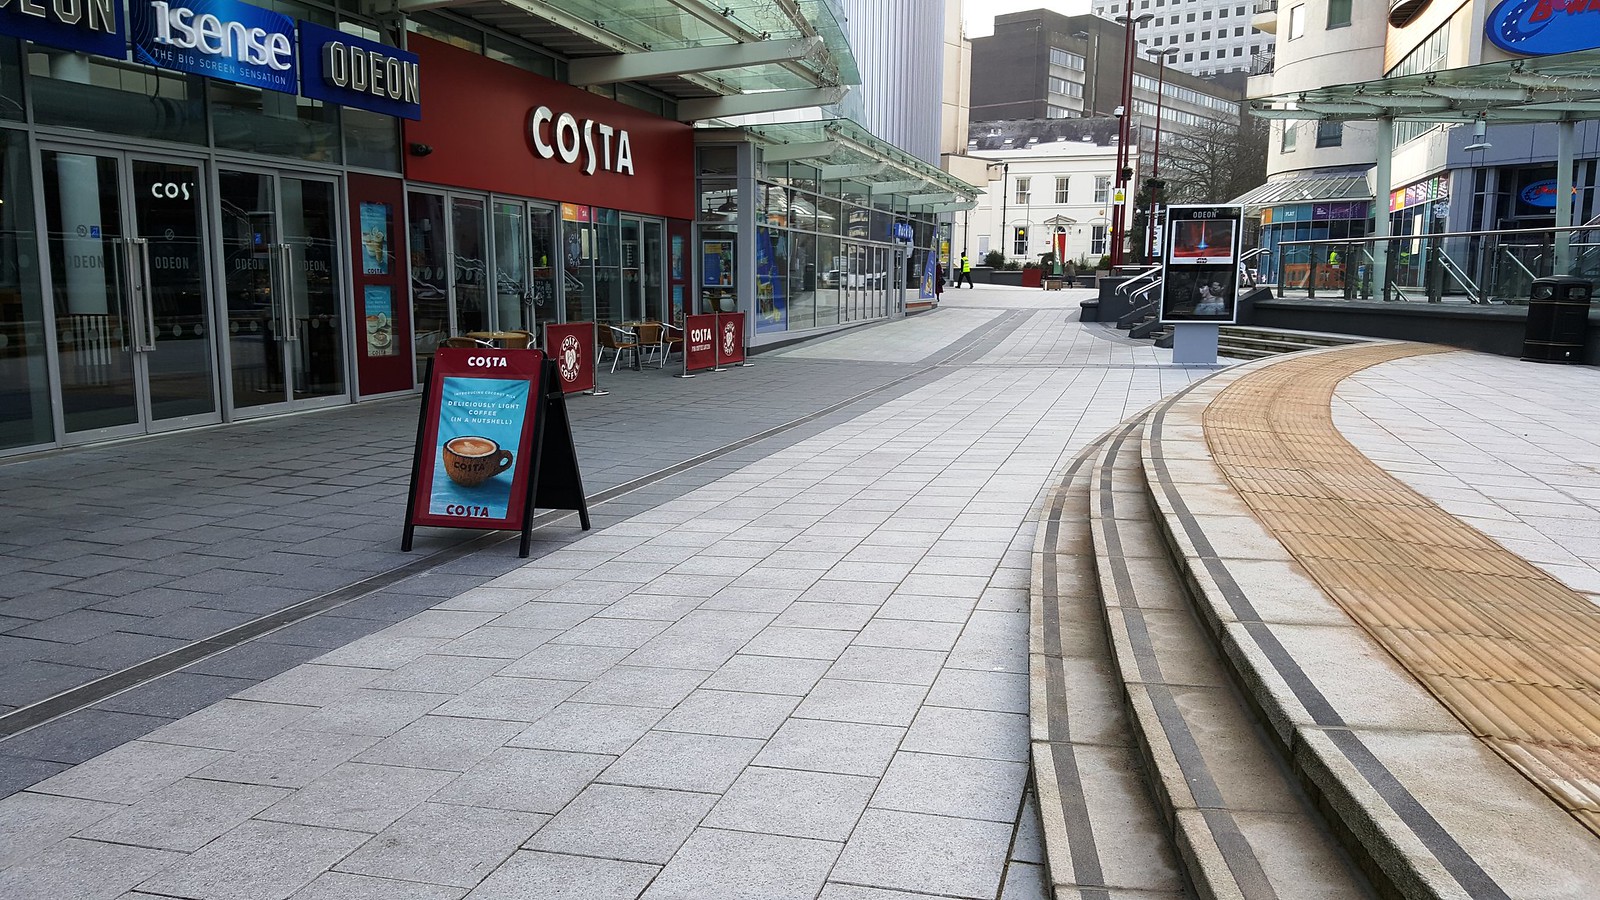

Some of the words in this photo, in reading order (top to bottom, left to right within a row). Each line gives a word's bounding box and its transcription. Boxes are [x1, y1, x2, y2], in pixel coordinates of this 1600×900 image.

[154, 48, 173, 61] THE
[178, 53, 195, 65] BIG
[200, 58, 235, 74] SCREEN
[240, 67, 286, 85] SENSATION
[323, 41, 419, 104] ODEON
[531, 105, 635, 176] COSTA
[151, 182, 194, 200] COS
[1192, 211, 1217, 219] ODEON
[155, 256, 190, 270] ODEON
[691, 328, 712, 343] COSTA
[467, 356, 507, 368] COSTA
[447, 400, 496, 408] DELICIOUSLY
[453, 461, 485, 472] COSTA
[446, 503, 490, 518] COSTA
